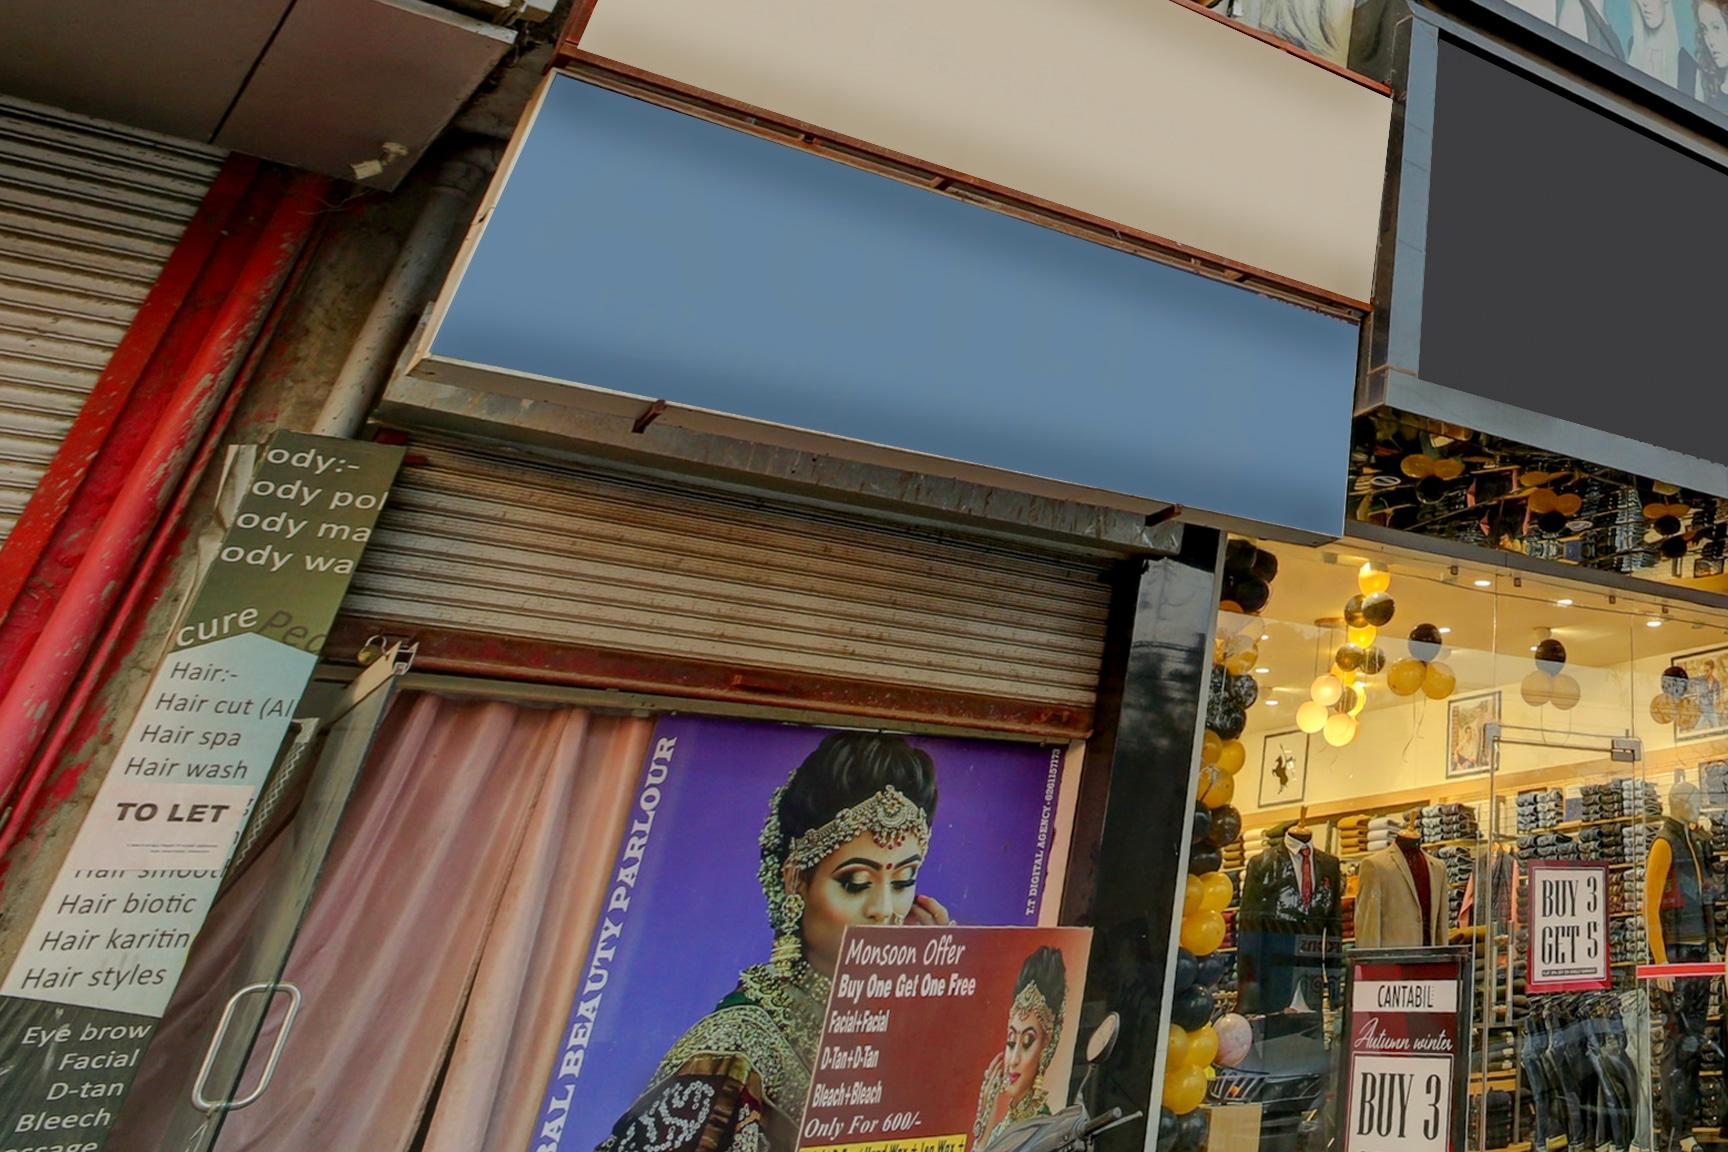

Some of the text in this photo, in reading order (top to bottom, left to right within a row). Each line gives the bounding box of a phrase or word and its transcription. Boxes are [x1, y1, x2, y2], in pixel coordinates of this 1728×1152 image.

[252, 479, 323, 506] ody
[236, 511, 372, 542] ody ma
[220, 545, 354, 574] ody wa
[176, 607, 259, 647] cure
[170, 662, 239, 682] Hair:-
[155, 693, 209, 713] Hair
[214, 699, 254, 715] cut
[139, 724, 241, 749] Hair spa
[123, 756, 248, 779] Hair wash
[116, 802, 158, 822] TO
[166, 803, 230, 823] LET
[1029, 849, 1044, 897] DIGITAL
[57, 892, 197, 915] Hair biotic
[557, 917, 624, 1079] BEAUTY
[607, 736, 678, 913] PARLOUR
[1541, 876, 1597, 917] BUY 3
[39, 928, 190, 951] Hair karitin
[844, 934, 966, 966] Monsoon Offer
[1541, 921, 1598, 965] GET 5
[21, 963, 167, 991] Hair styles
[837, 973, 977, 1004] Buy One Get One Free
[1377, 984, 1433, 1008] CANTABIL
[21, 1022, 152, 1047] Eye brow
[828, 1009, 890, 1034] Facial+Facial
[1354, 1017, 1453, 1051] Autumn winter
[58, 1049, 140, 1071] Facial
[820, 1045, 880, 1070] D-Tan+D-Tan
[46, 1081, 124, 1101] D-tan
[812, 1080, 883, 1108] Bleach+Bleach
[1356, 1072, 1441, 1140] BUY 3
[14, 1107, 111, 1133] Bleech
[804, 1111, 922, 1141] Only For 600/-
